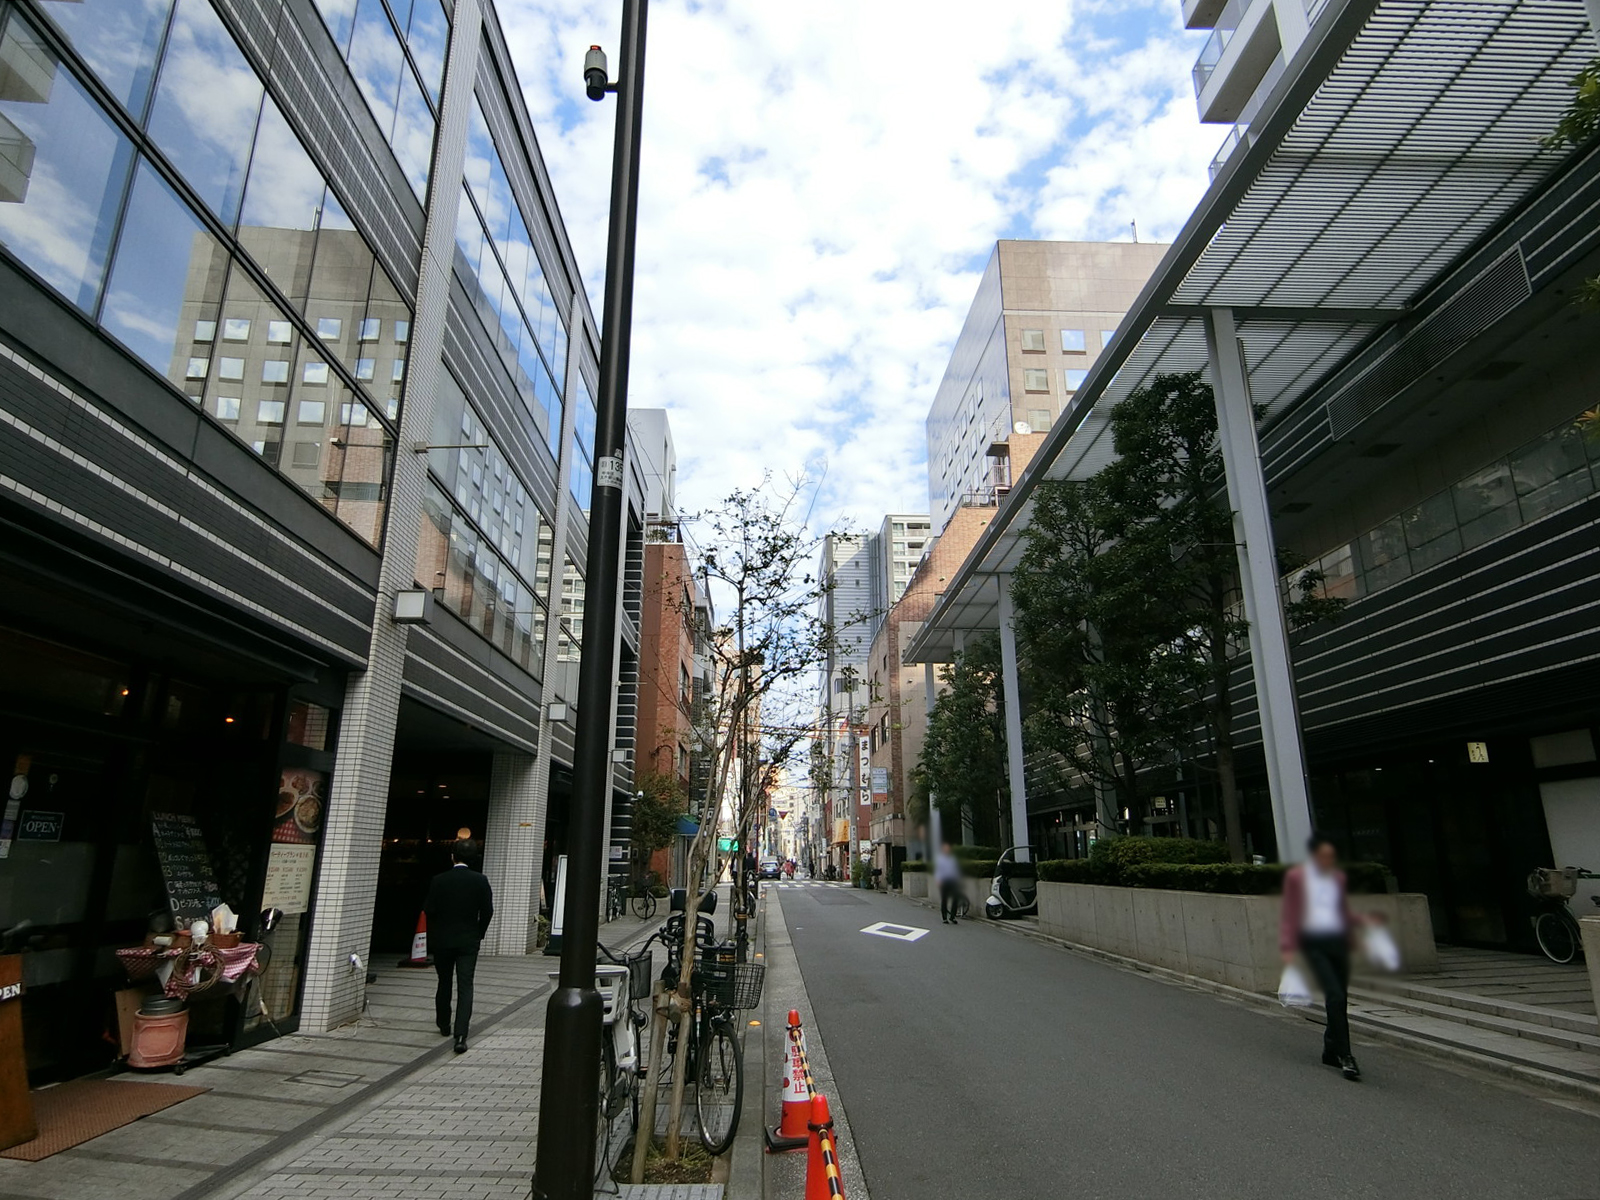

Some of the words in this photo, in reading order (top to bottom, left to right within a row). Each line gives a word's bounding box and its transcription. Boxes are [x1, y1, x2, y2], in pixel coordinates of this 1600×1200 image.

[861, 740, 870, 802] まつむら
[26, 820, 56, 833] OPEN
[167, 881, 176, 894] C
[170, 898, 180, 911] D
